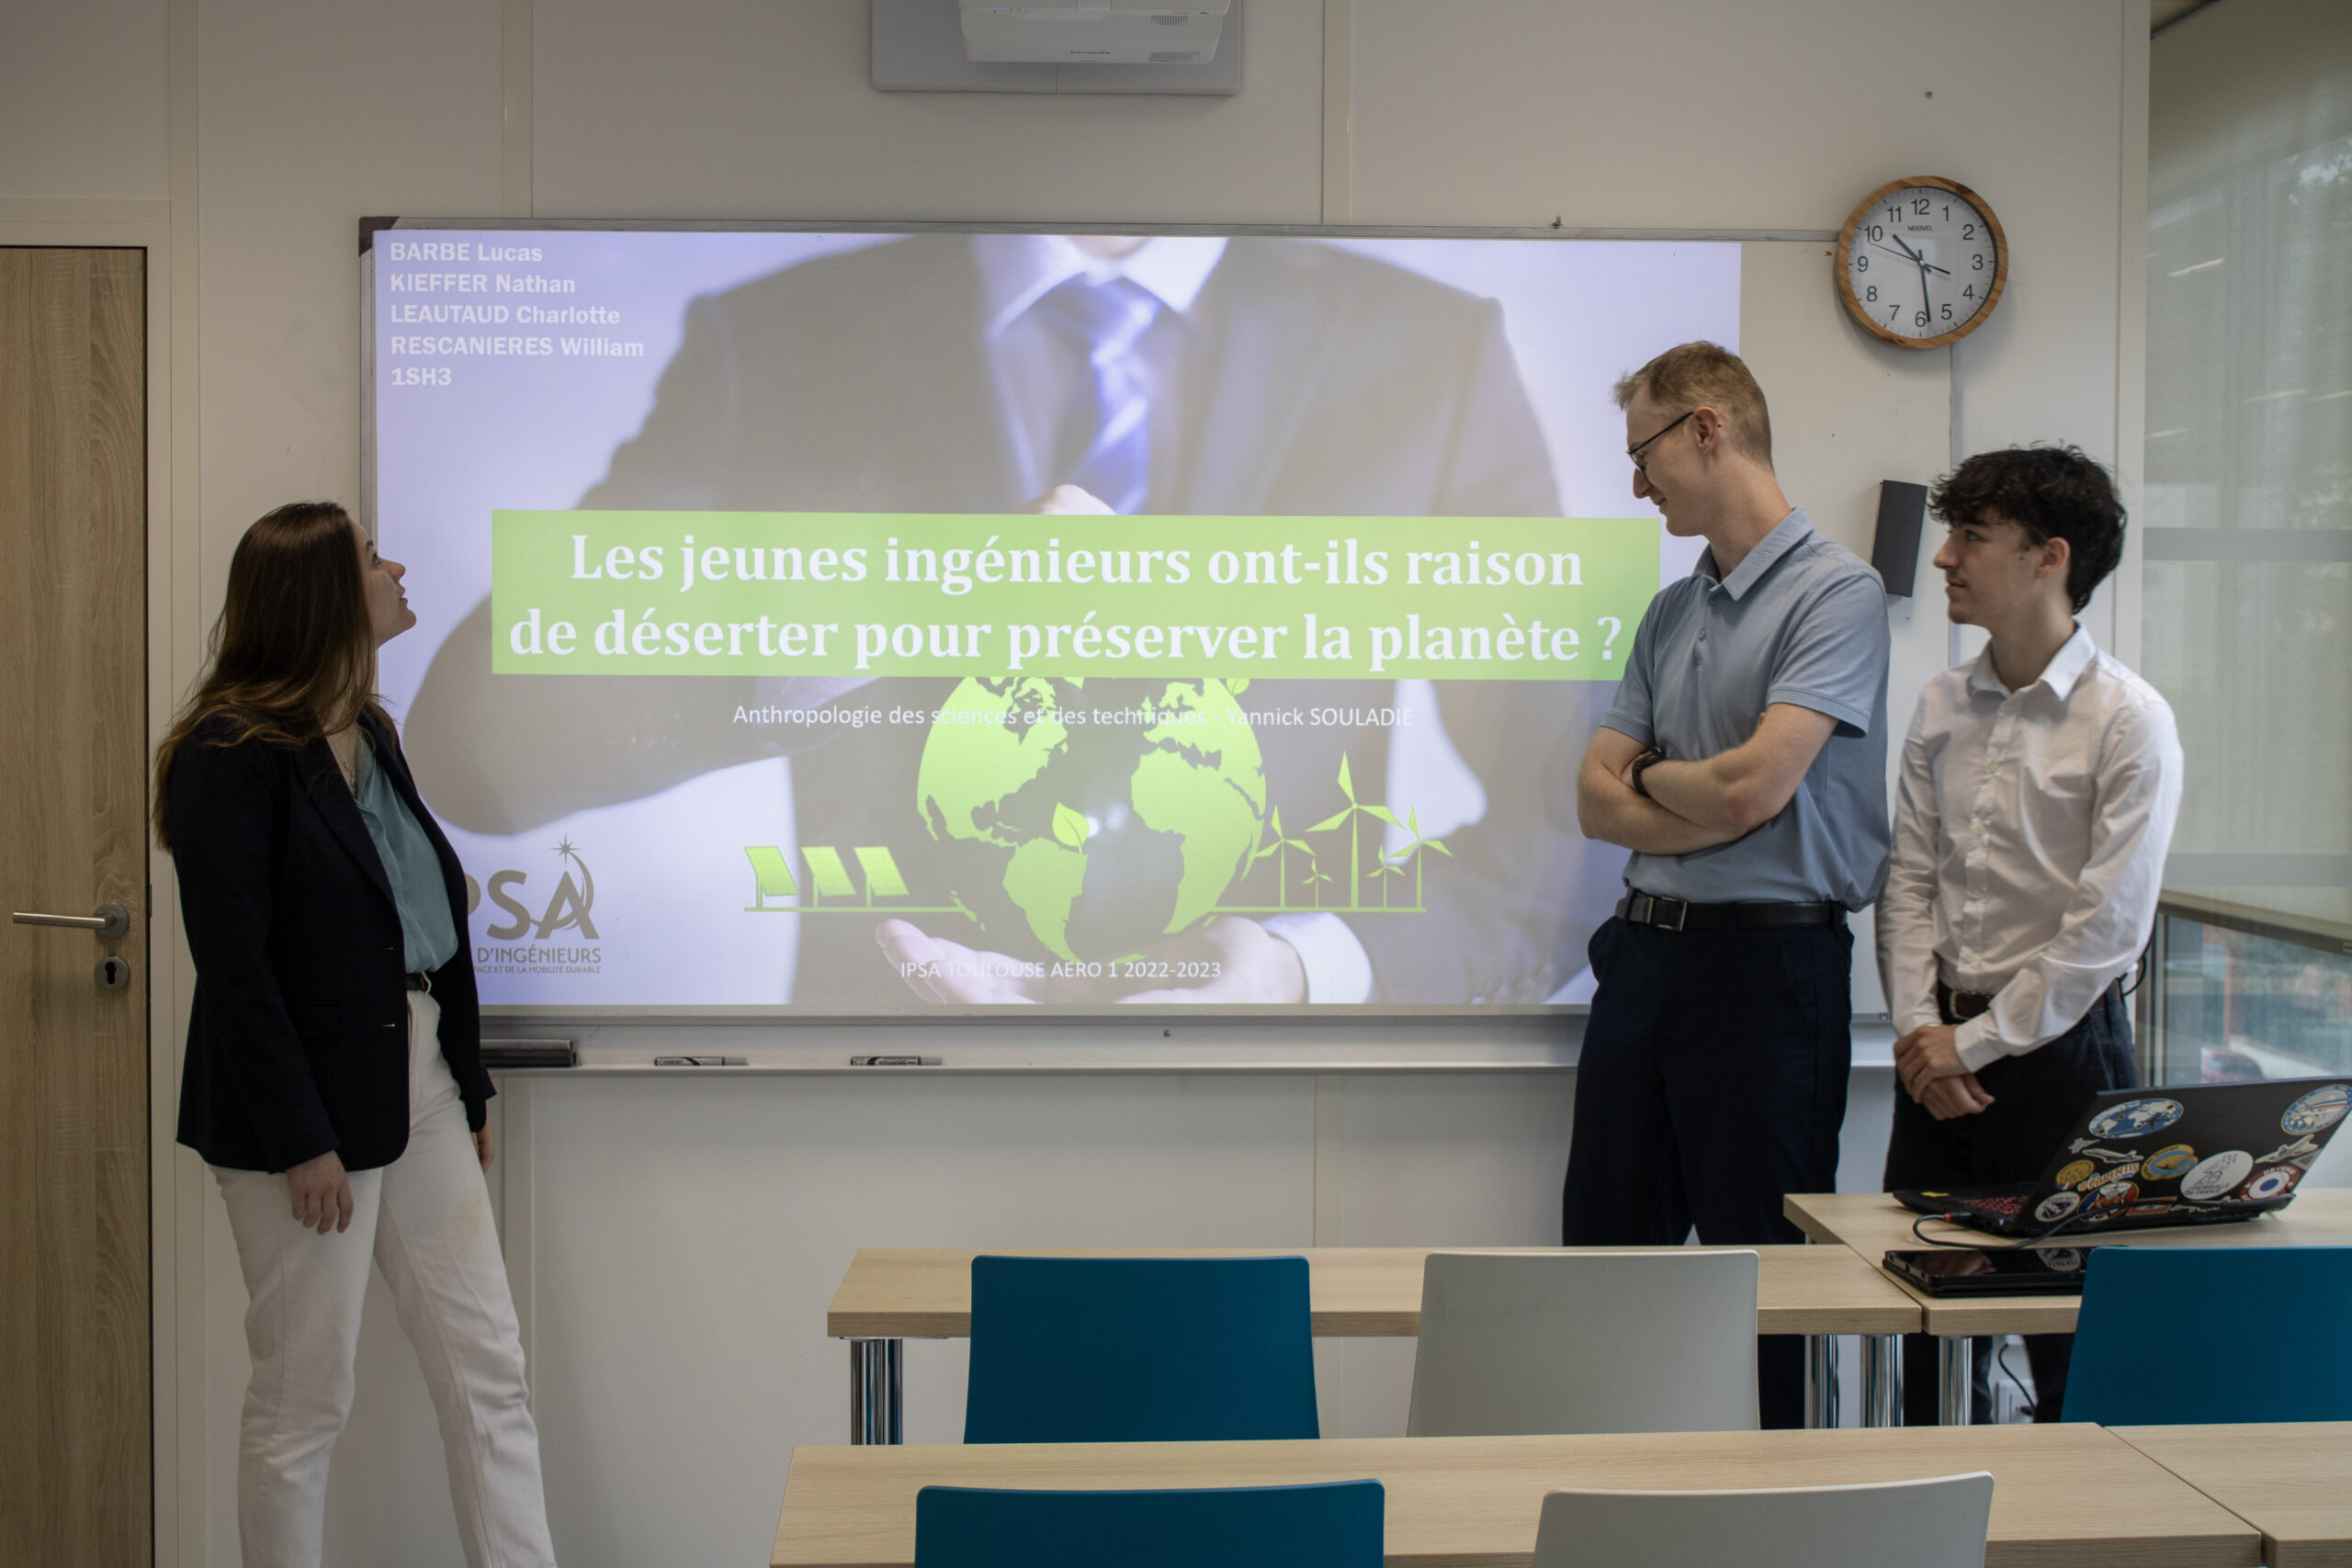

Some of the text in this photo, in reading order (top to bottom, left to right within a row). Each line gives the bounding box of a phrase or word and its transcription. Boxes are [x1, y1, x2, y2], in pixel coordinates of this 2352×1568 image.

[1886, 206, 1902, 222] 11
[1911, 198, 1930, 215] 12
[1941, 205, 1950, 221] 1
[1863, 225, 1883, 242] 10
[1962, 224, 1974, 240] 2
[390, 243, 543, 262] BARBE Lucas
[1857, 256, 1869, 272] 9
[1972, 254, 1984, 270] 3
[390, 274, 575, 293] KIEFFER Nathan
[1866, 286, 1878, 301] 8
[1962, 284, 1974, 300] 4
[390, 305, 621, 324] LEAUTAUD Charlotte
[1889, 305, 1900, 321] 7
[1915, 311, 1927, 327] 6
[1940, 304, 1952, 320] 5
[390, 336, 644, 356] RESCANIERES William
[390, 367, 452, 386] 1SH3
[571, 535, 1583, 595] Les jeunes ingénieurs ont-ils raison
[510, 607, 1623, 671] de déserter pour préserver la planète ?
[733, 705, 882, 728] Anthropologie
[889, 705, 924, 725] des
[931, 706, 1017, 725] sciences
[1023, 707, 1044, 725] et
[1051, 705, 1086, 725] des
[1092, 705, 1206, 728] techniques
[1226, 706, 1304, 726] Yannick
[1310, 707, 1414, 727] SOULADIE
[478, 944, 602, 964] D'INGÉNIEURS
[494, 965, 503, 974] ET
[505, 965, 515, 974] DE
[516, 965, 526, 974] LA
[565, 965, 601, 974] DURABLE
[900, 962, 1222, 978] IPSA TOULOUSE AERO 1 2022-2023
